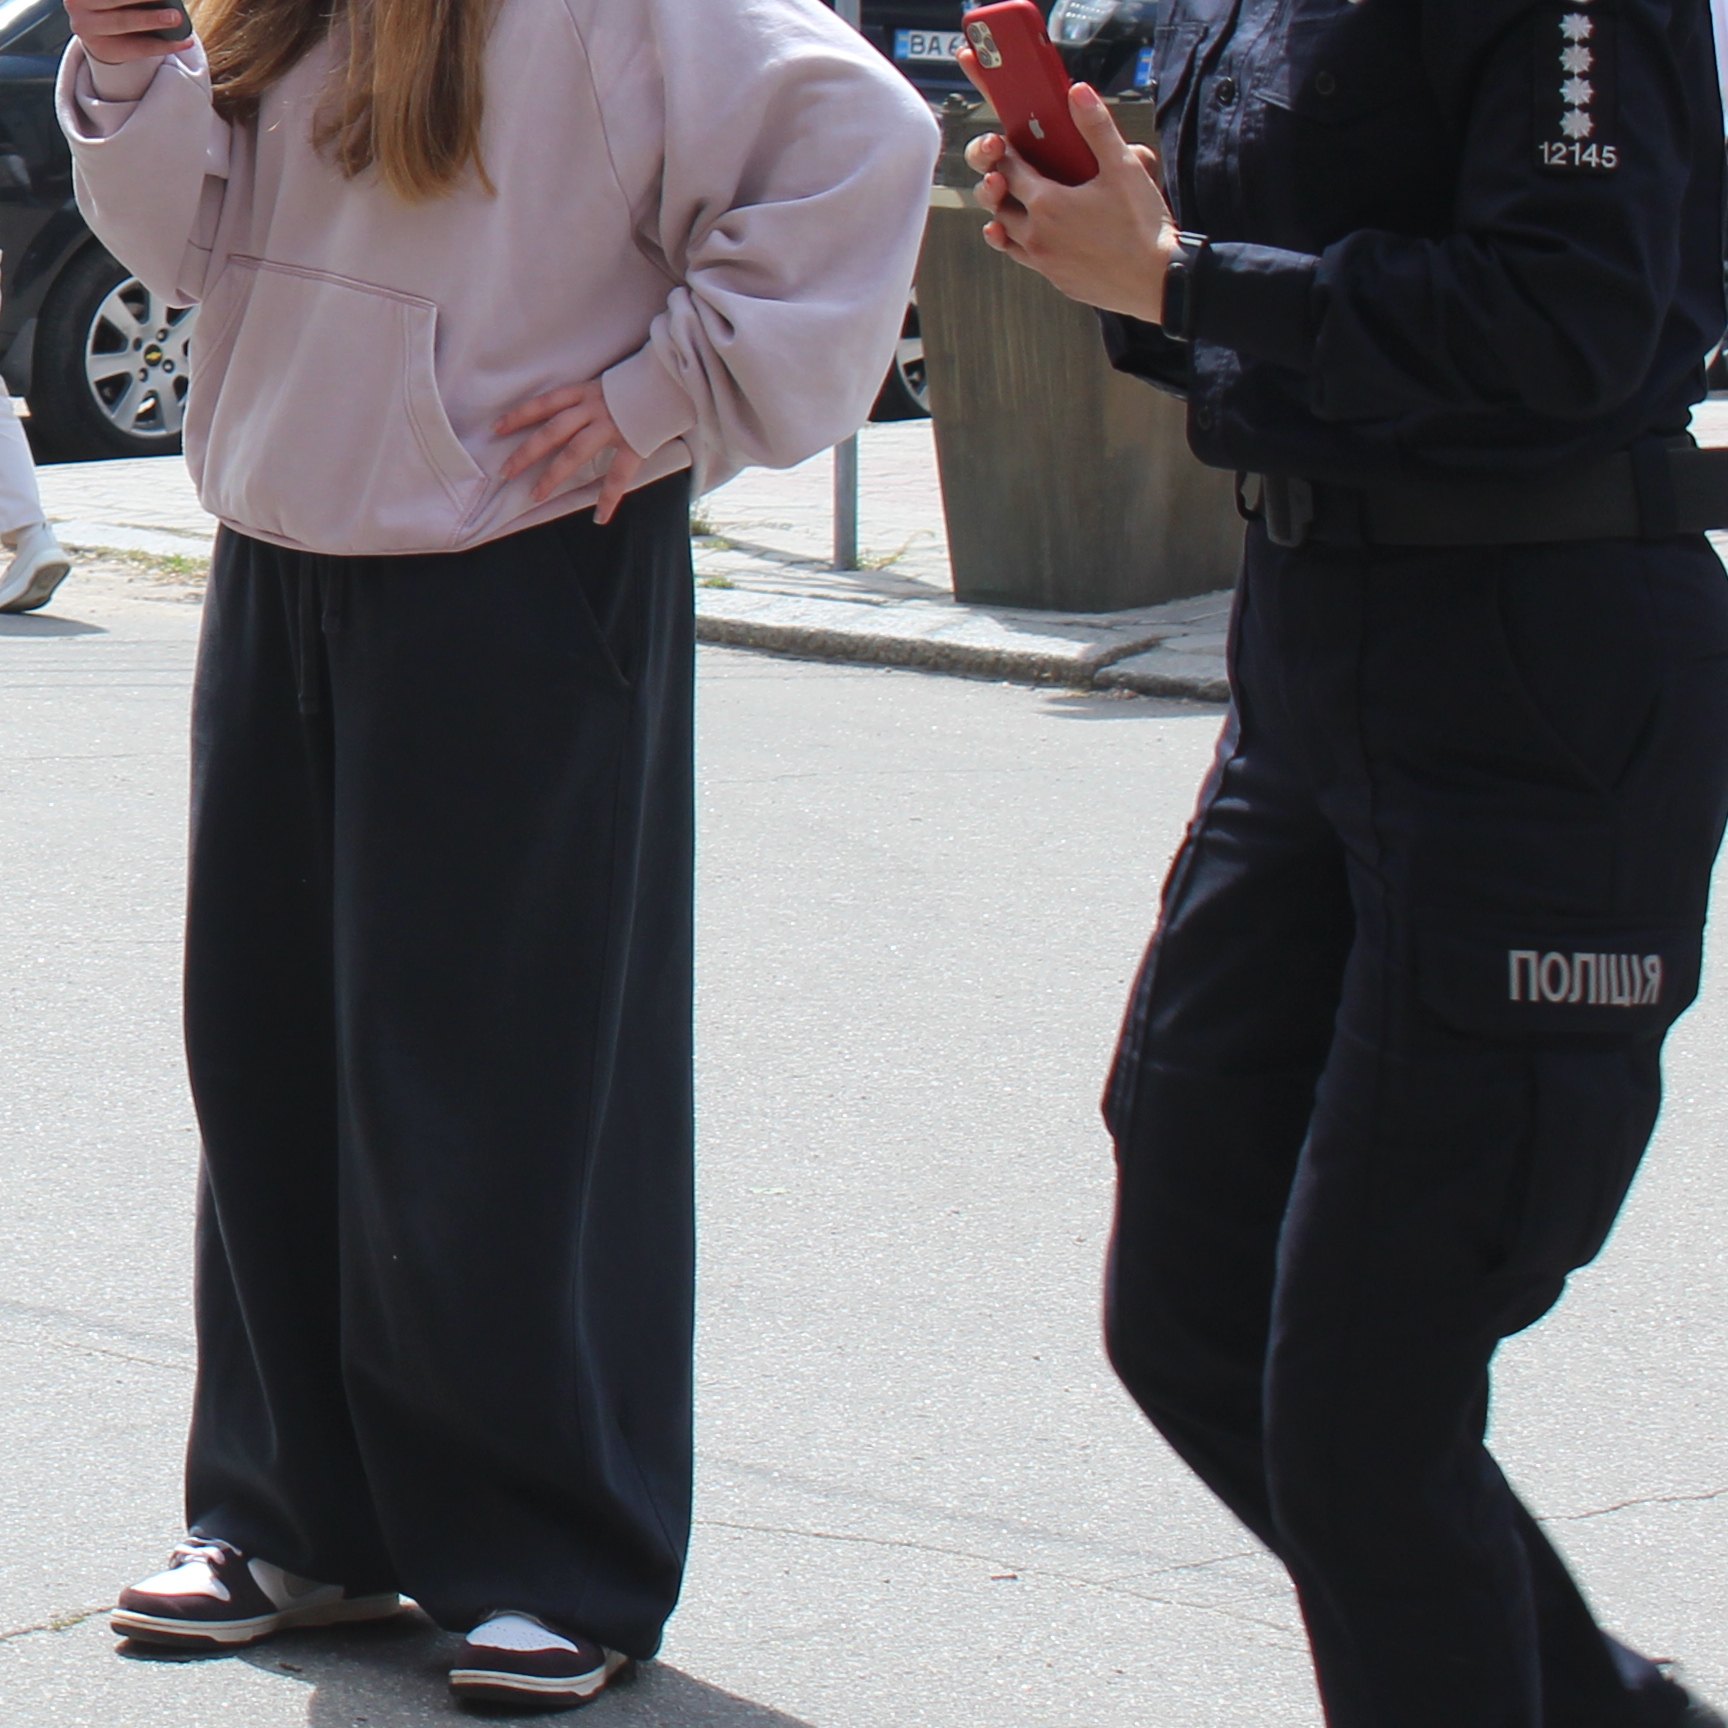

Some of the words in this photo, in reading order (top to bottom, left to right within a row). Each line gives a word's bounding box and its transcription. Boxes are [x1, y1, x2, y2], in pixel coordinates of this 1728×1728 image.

[910, 34, 942, 55] BA
[1538, 140, 1618, 169] 12145
[1507, 949, 1663, 1007] ПОЛІЦІЯ
